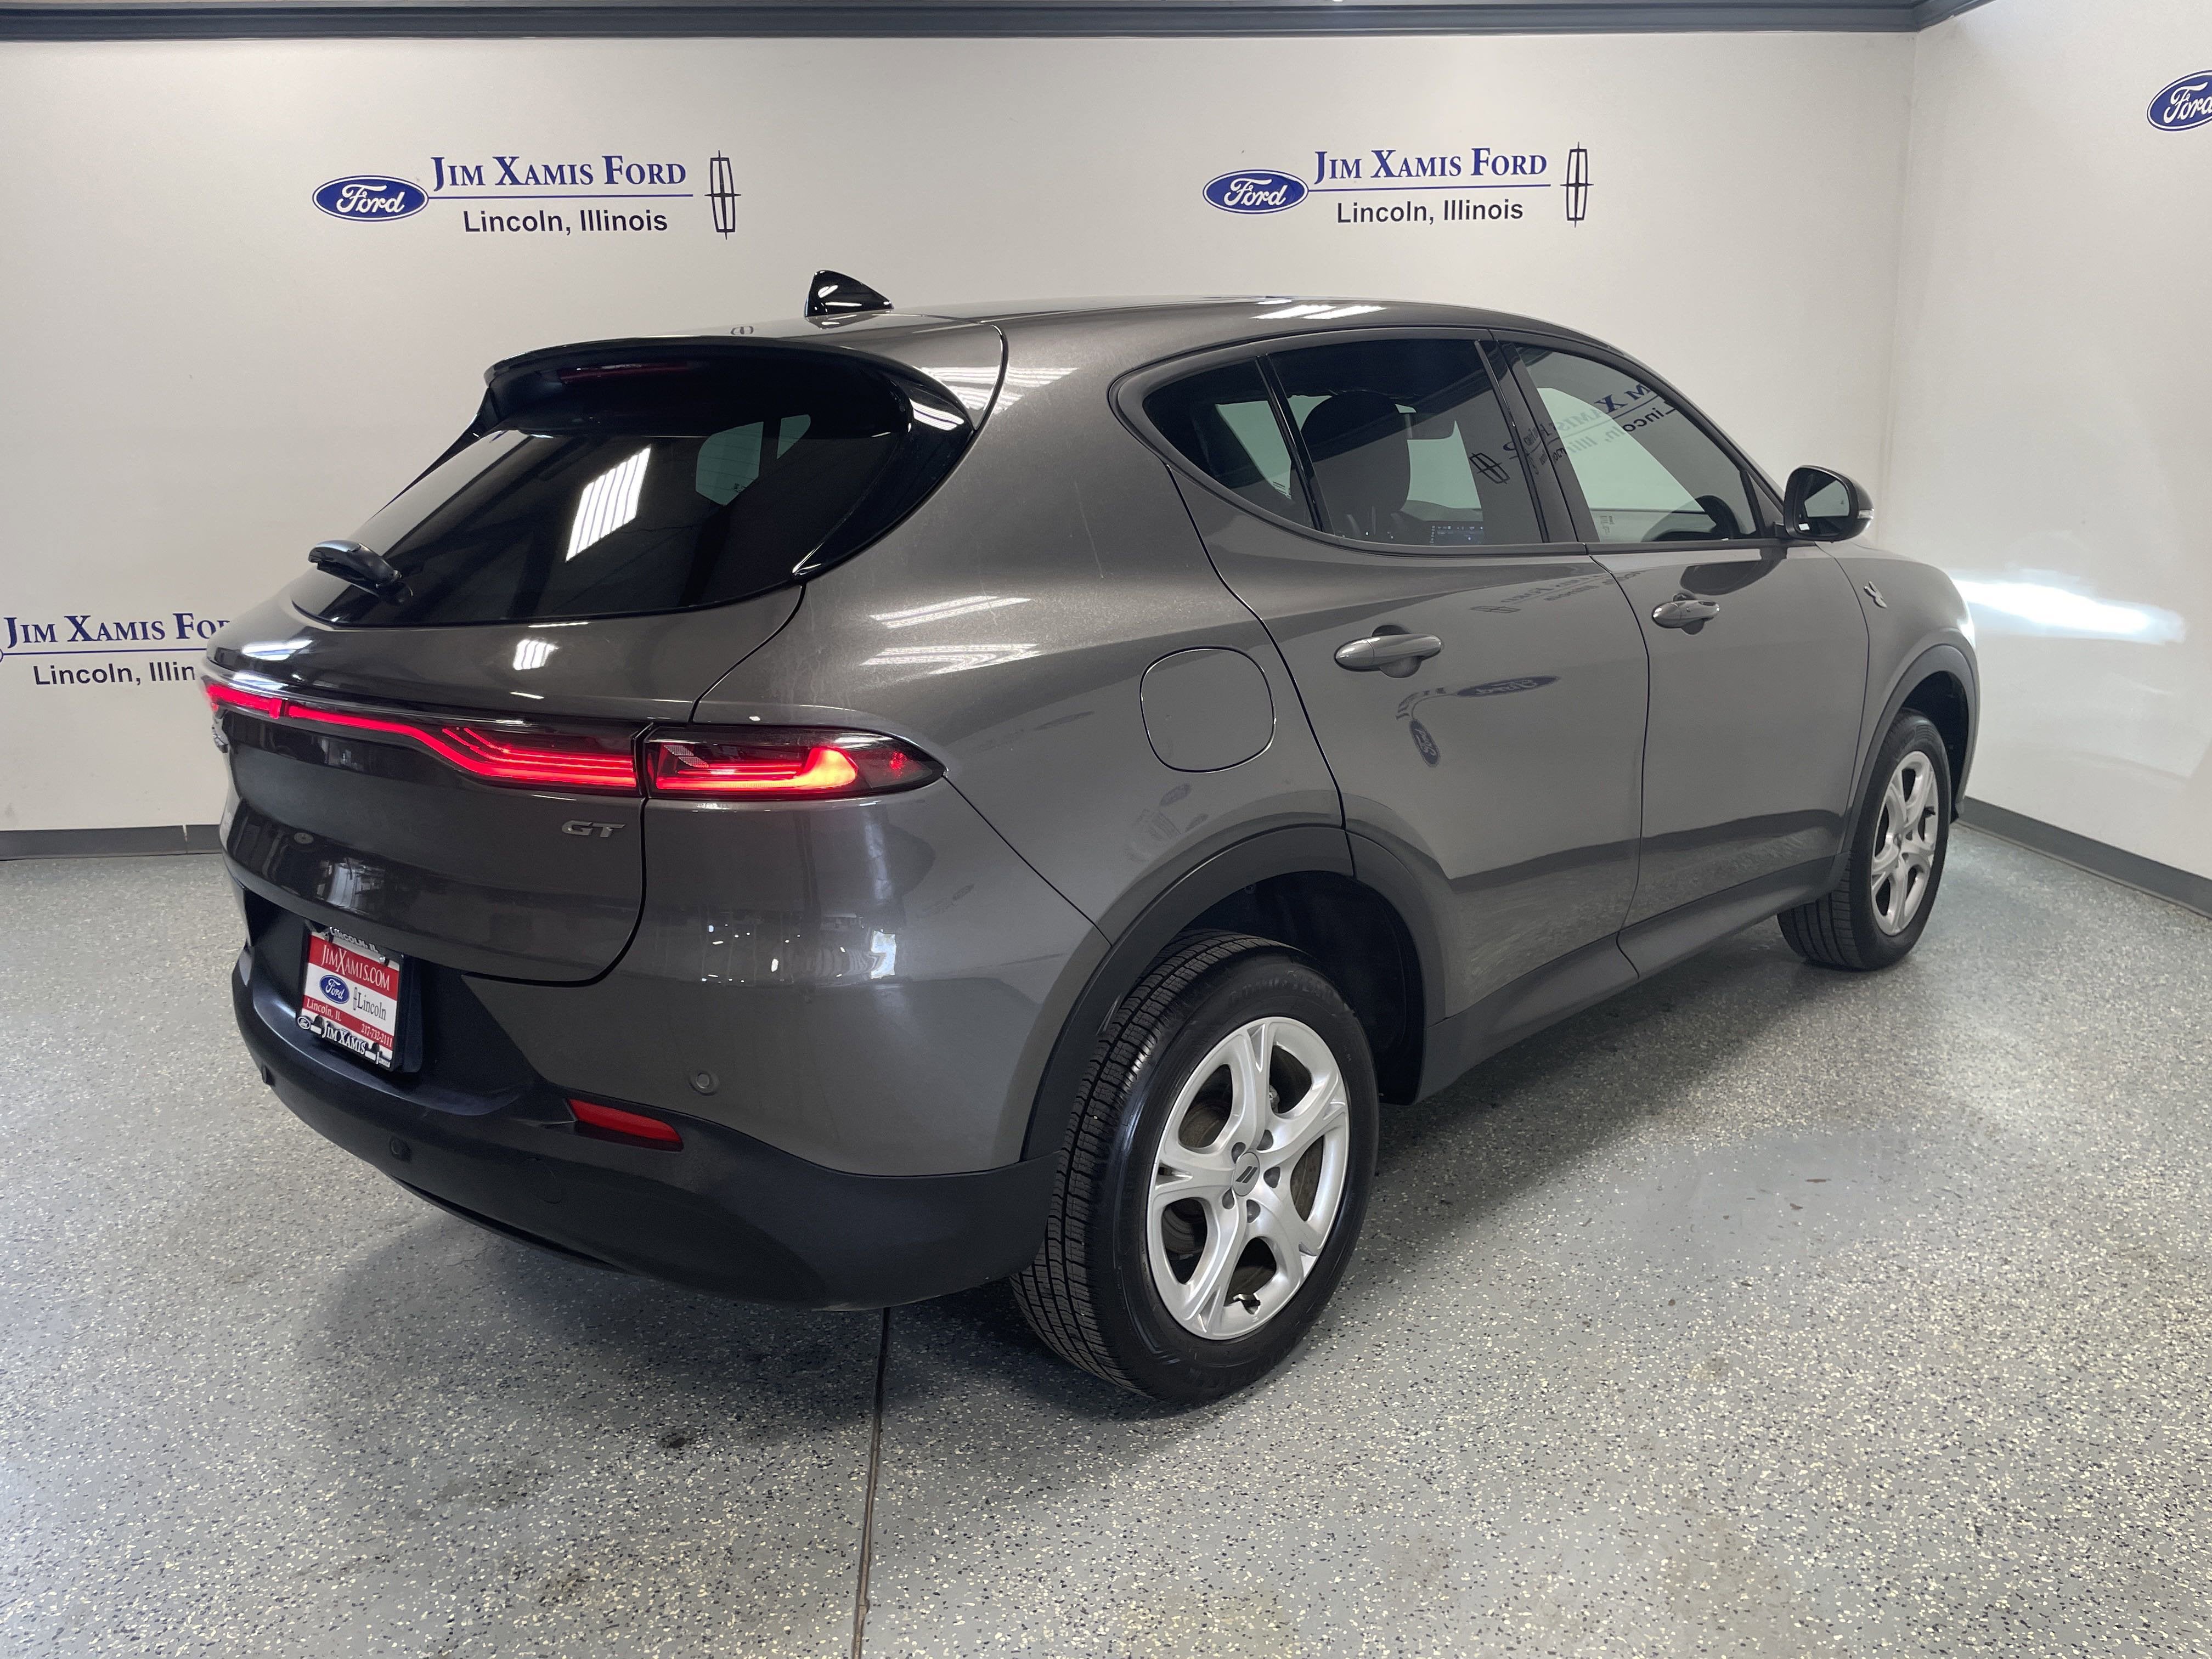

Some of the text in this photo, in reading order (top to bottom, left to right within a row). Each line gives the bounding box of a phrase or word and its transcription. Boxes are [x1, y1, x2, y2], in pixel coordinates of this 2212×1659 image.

[431, 156, 686, 191] JIM XAMIS FORD
[1314, 148, 1547, 184] JIM XAMIS FORD
[336, 183, 405, 213] Ford
[1224, 177, 1286, 206] Ford
[464, 210, 668, 235] Lincoln, Illinois
[1338, 199, 1523, 225] Lincoln, Illinois
[3, 613, 230, 648] JIM XAMIS FO
[33, 662, 195, 685] Lincoln, Illin
[562, 820, 627, 838] GT
[321, 944, 390, 991] JIMXAMIS.COM
[325, 978, 345, 1000] Ford
[306, 998, 342, 1022] Lincoln, IL
[357, 992, 386, 1020] Lincoln
[322, 1022, 337, 1042] JIM
[337, 1029, 366, 1054] XAMIS
